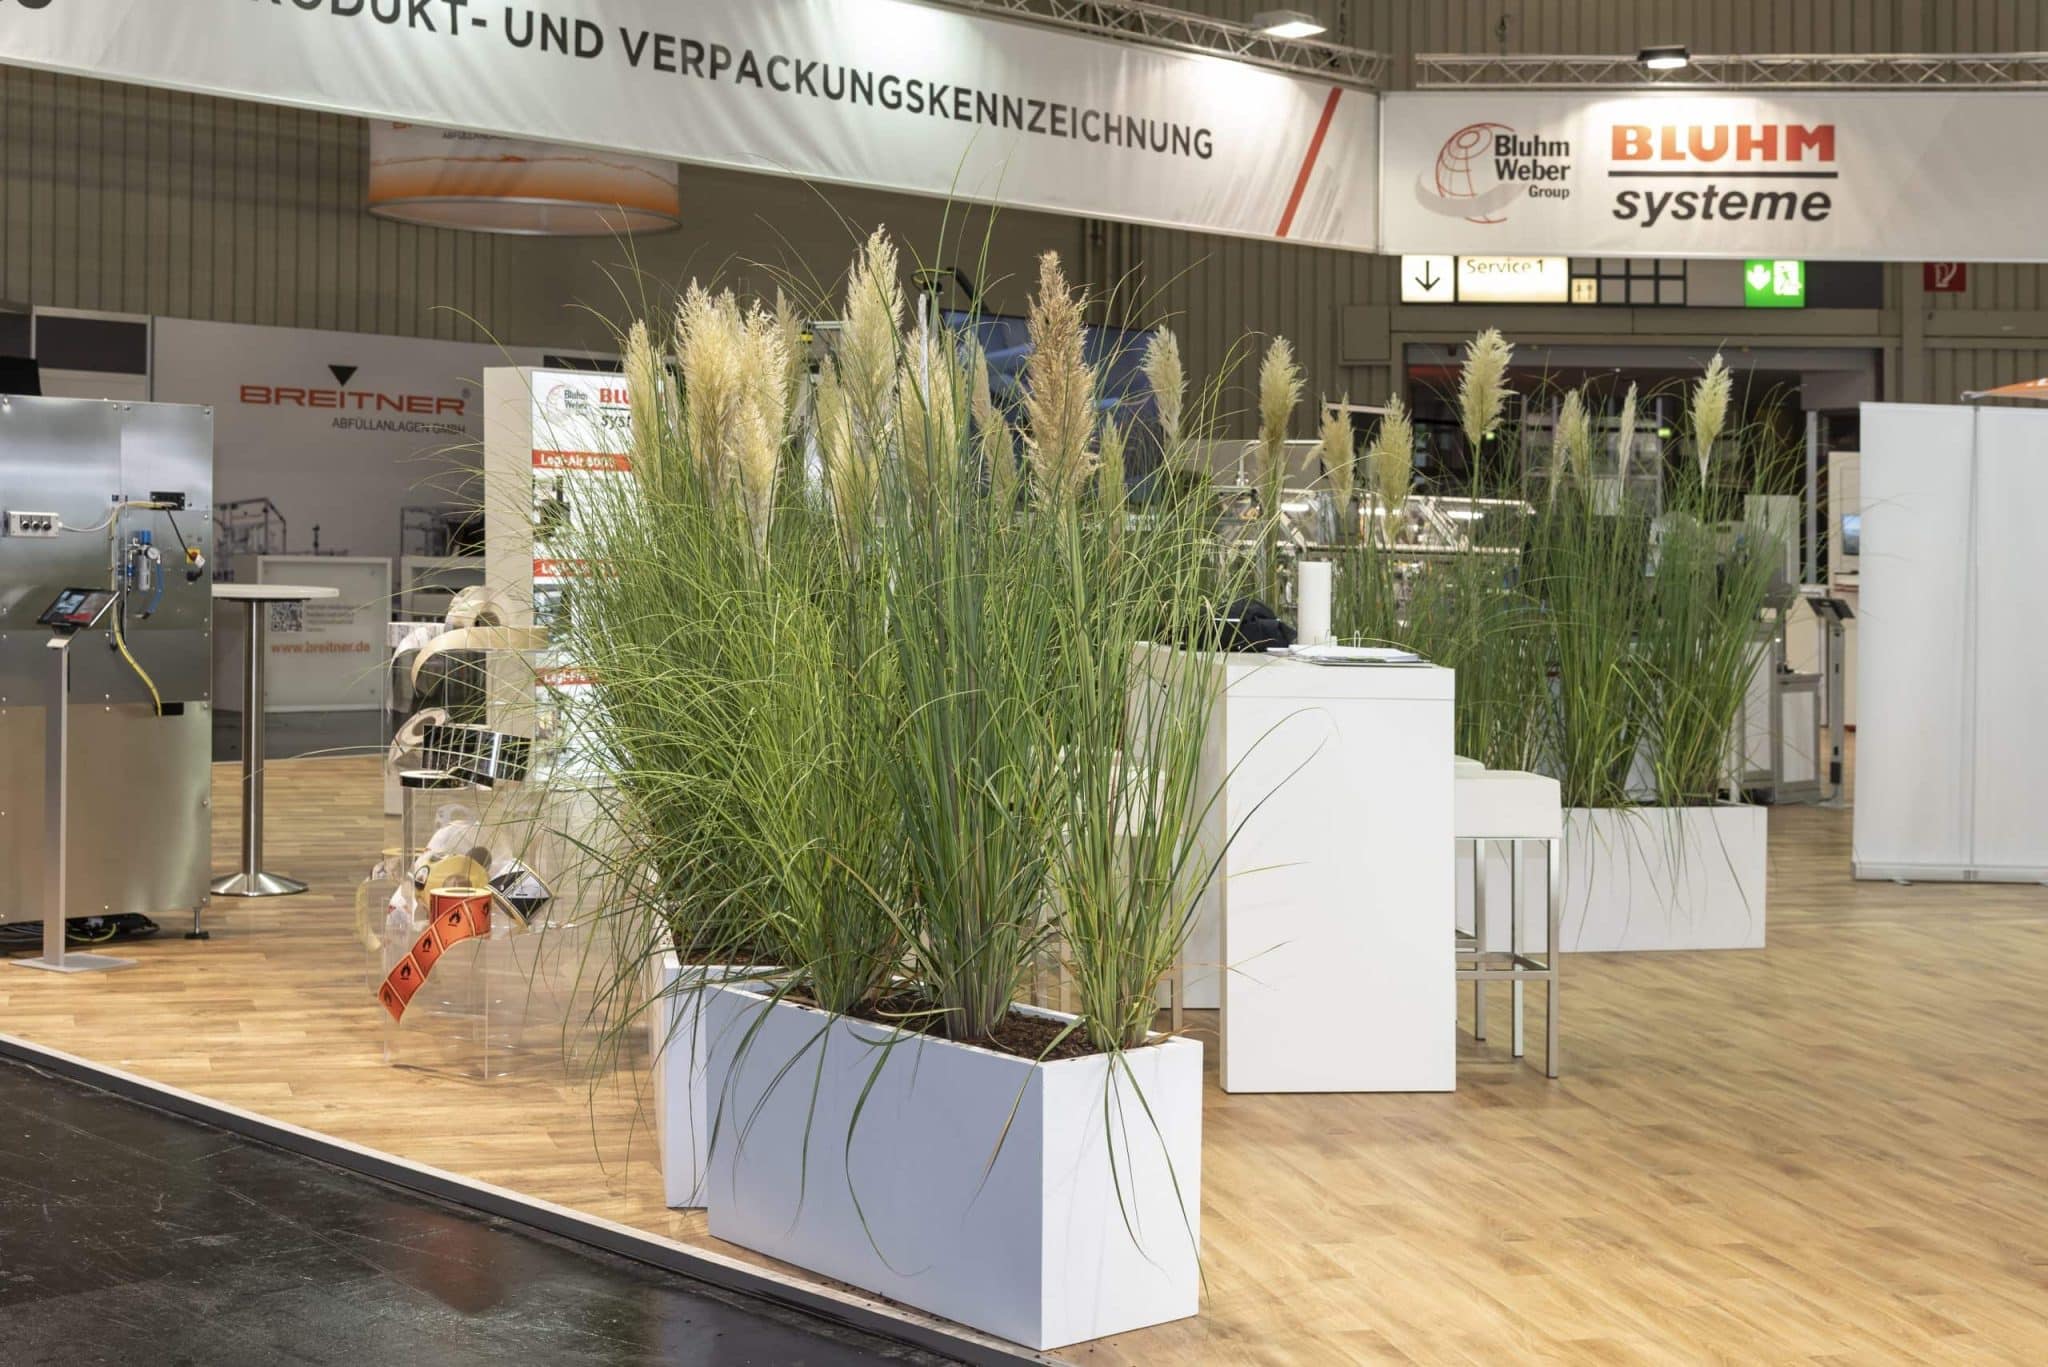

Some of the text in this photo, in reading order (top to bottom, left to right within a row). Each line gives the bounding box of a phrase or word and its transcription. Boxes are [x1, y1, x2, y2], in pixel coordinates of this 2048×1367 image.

[505, 7, 604, 59] UND
[619, 27, 1214, 160] VERPACKUNGSKENNZEICHNUNG
[1494, 134, 1571, 157] Bluhm
[1611, 124, 1836, 163] BLUHM
[1494, 159, 1572, 181] Weber
[1528, 185, 1570, 200] Group
[1612, 184, 1833, 228] systeme
[1466, 257, 1545, 274] Service 1
[239, 384, 466, 417] BREITNER
[331, 416, 430, 433] ABFÜLLANLAGEN
